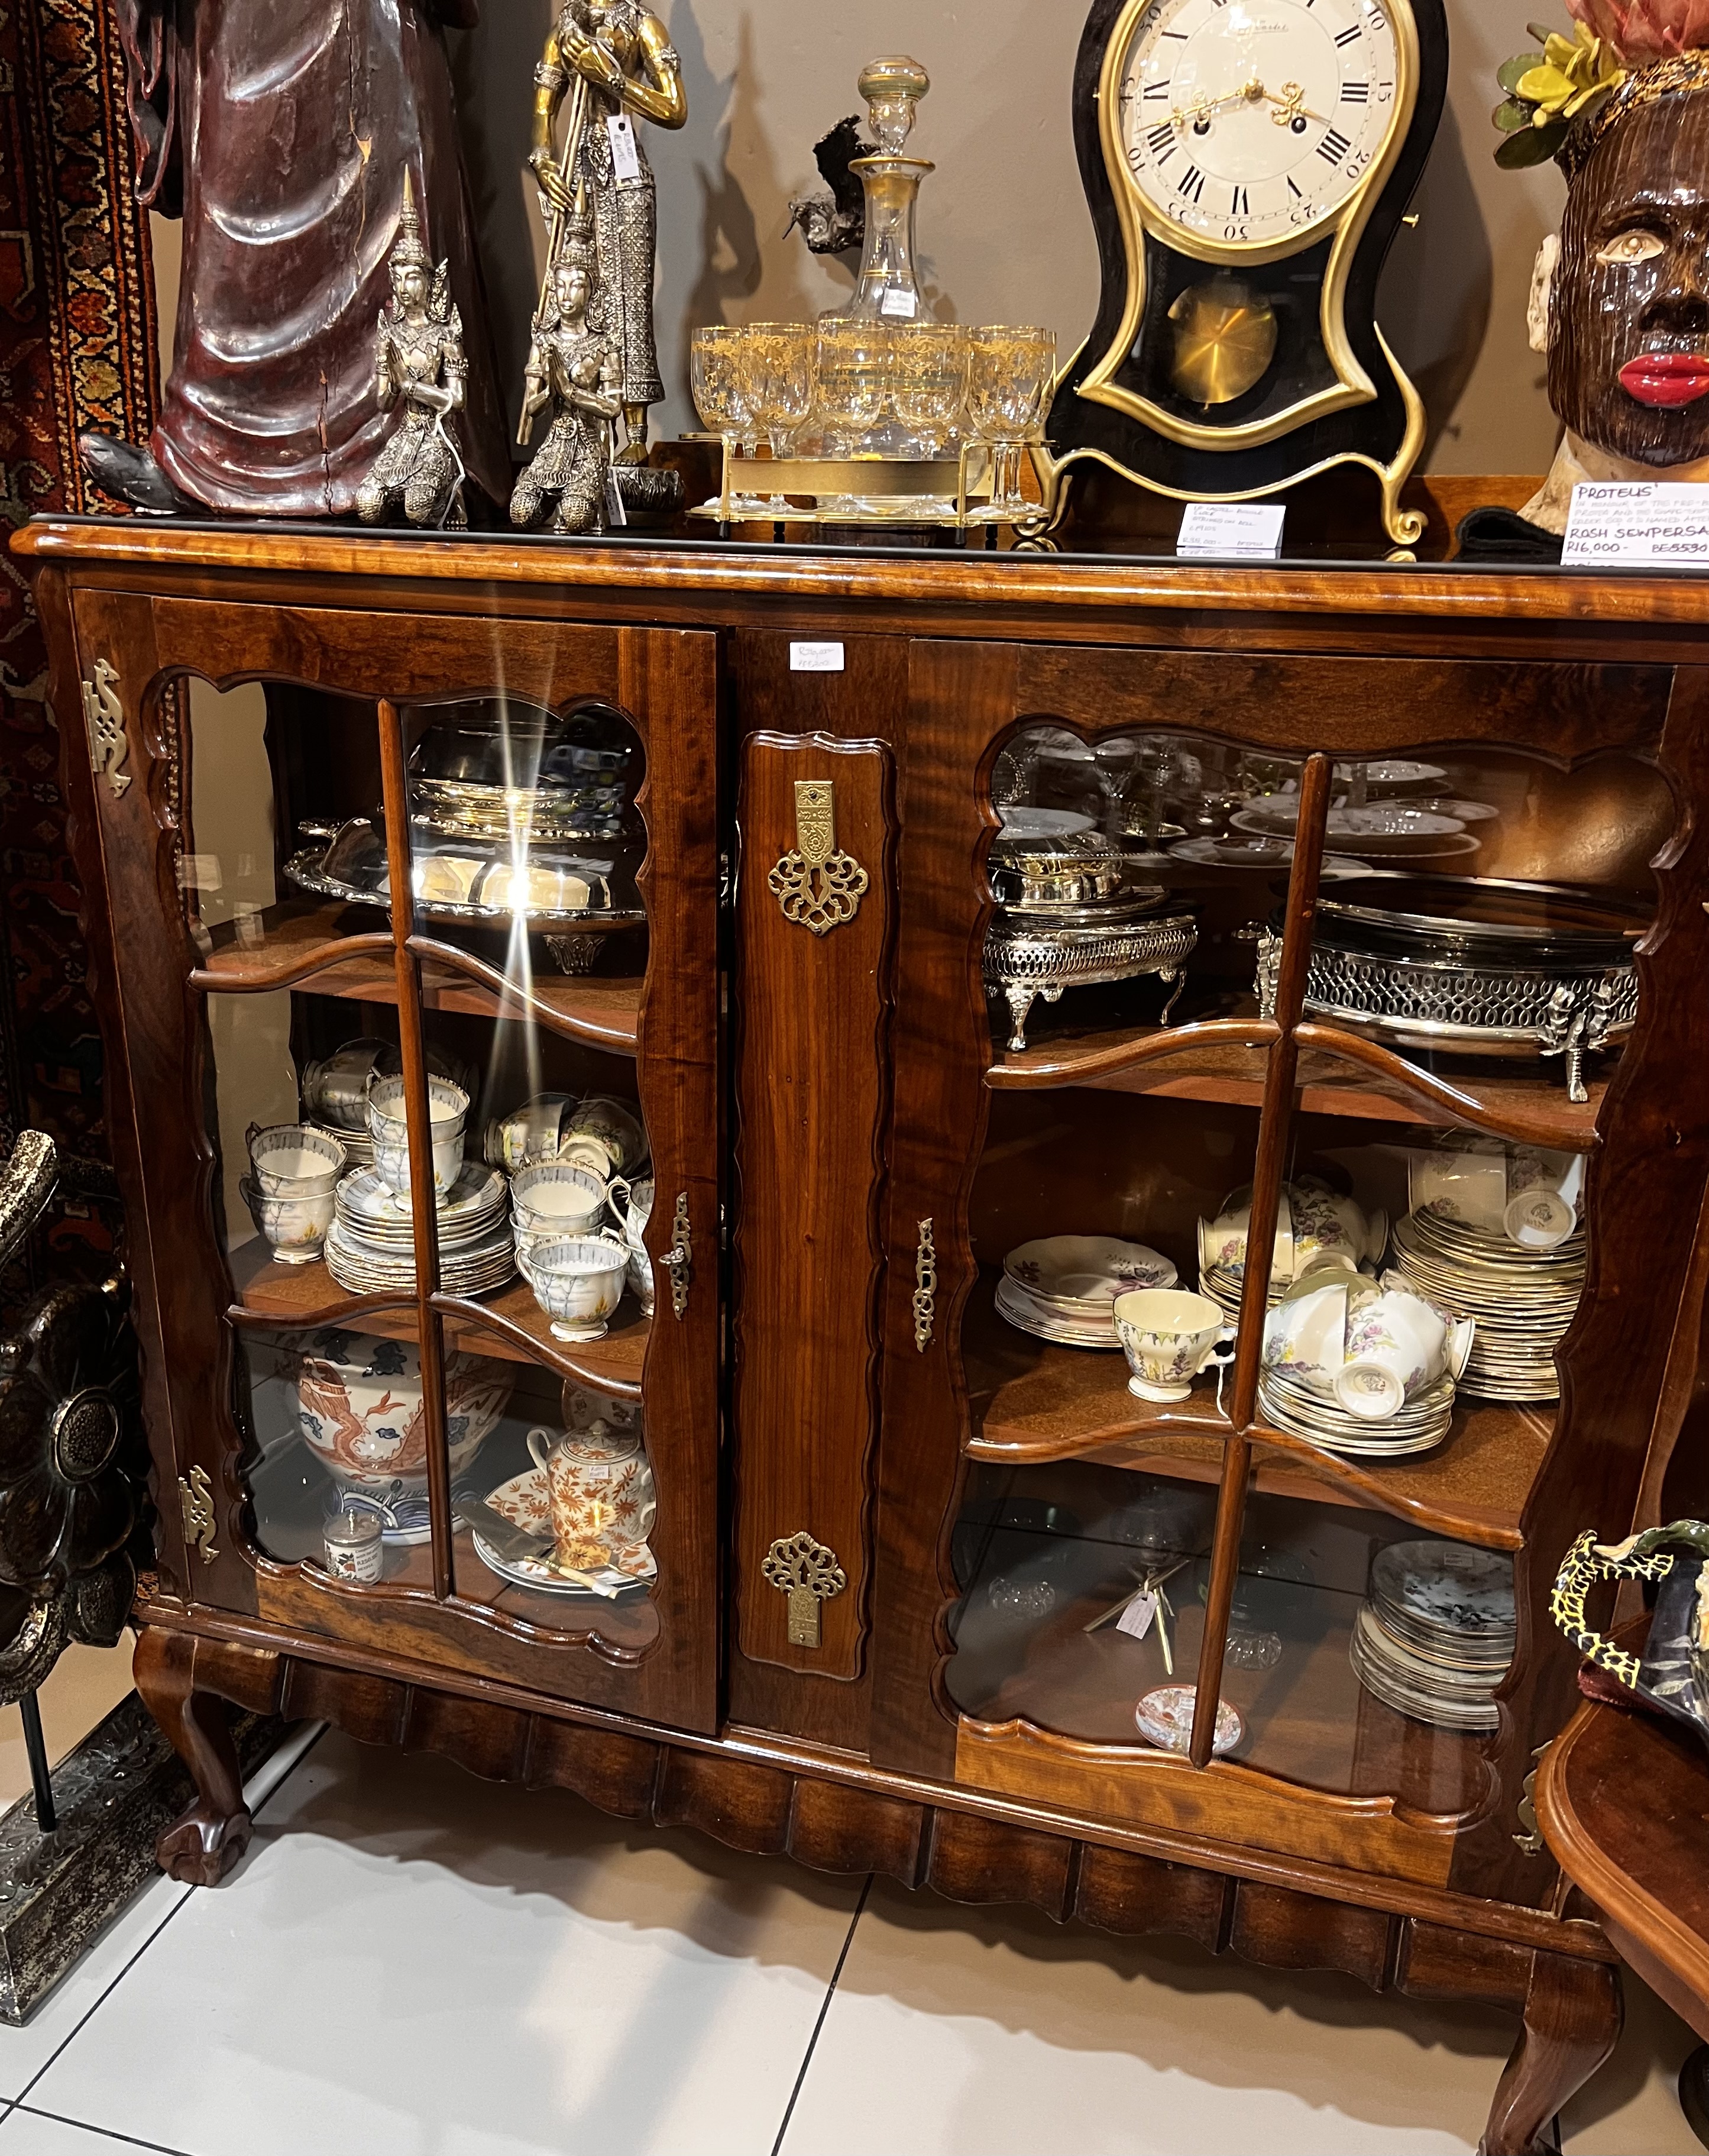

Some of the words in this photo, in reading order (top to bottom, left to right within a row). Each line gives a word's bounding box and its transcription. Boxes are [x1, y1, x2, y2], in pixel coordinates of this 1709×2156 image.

[1367, 6, 1386, 31] 10
[1333, 23, 1362, 49] II
[1340, 82, 1370, 103] III
[1377, 81, 1394, 103] 15
[1147, 122, 1179, 167] VIII
[1315, 128, 1352, 167] IIII
[1346, 148, 1370, 179] 20
[1177, 165, 1206, 203] VII
[1286, 174, 1303, 205] V
[1231, 186, 1249, 215] VI
[1290, 203, 1317, 228] 25
[1224, 225, 1251, 242] 30
[1569, 527, 1608, 539] ROSH
